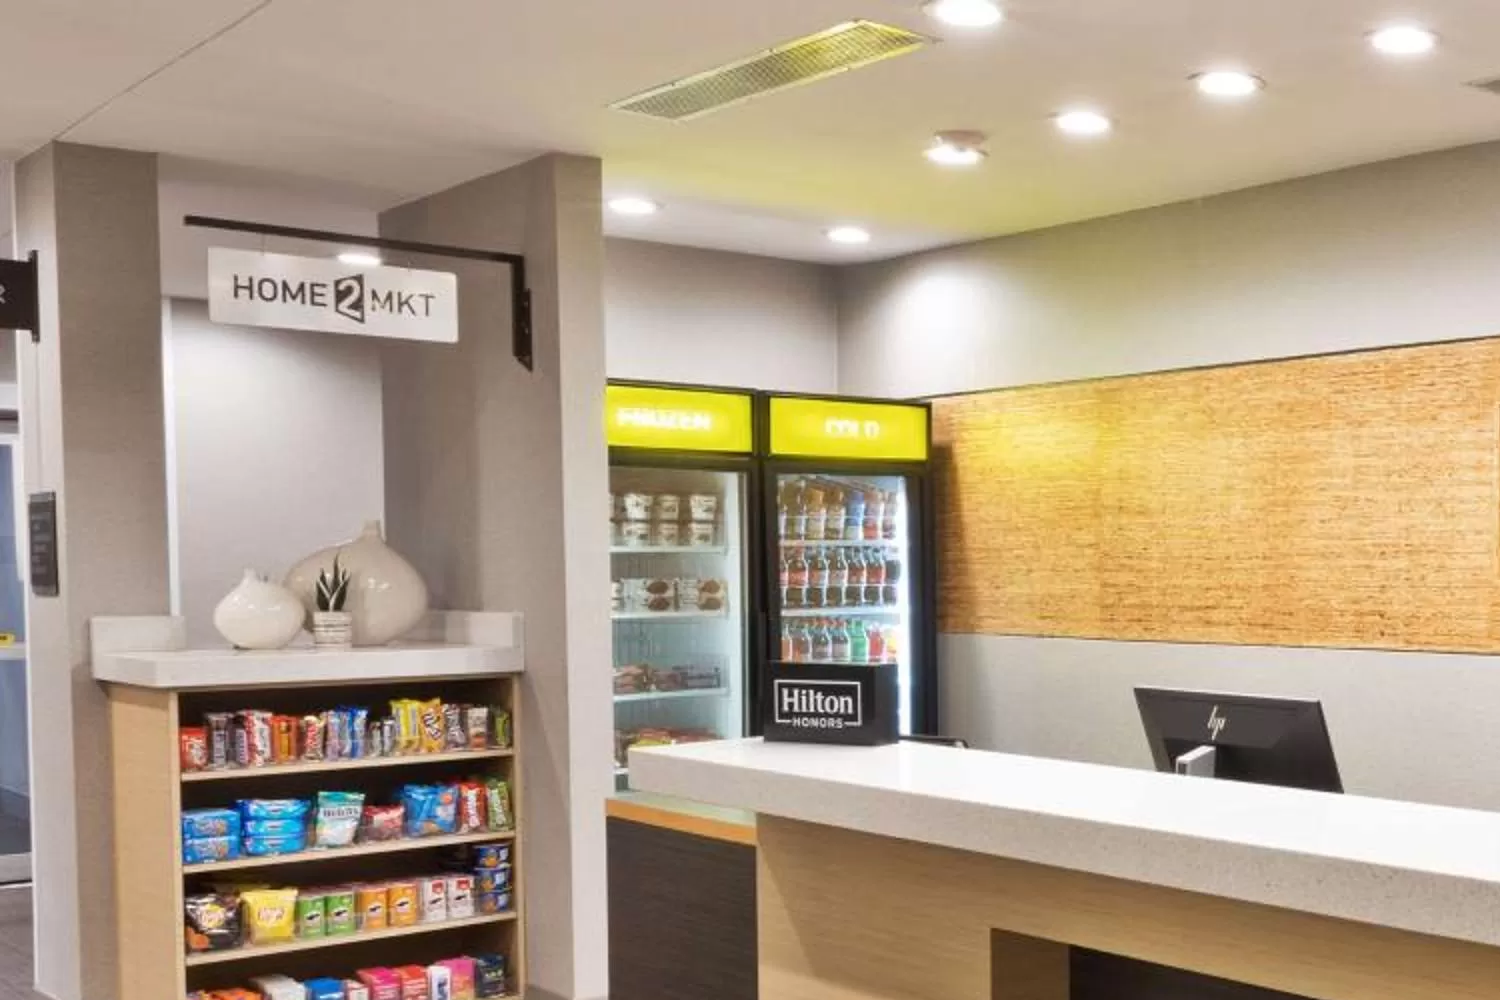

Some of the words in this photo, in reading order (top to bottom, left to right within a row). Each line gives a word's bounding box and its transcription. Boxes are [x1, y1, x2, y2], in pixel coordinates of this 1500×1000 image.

[233, 273, 328, 308] HOME
[337, 278, 362, 318] 2
[371, 288, 436, 318] MKT
[782, 687, 854, 715] Hilton
[791, 716, 844, 729] HONORS
[1207, 704, 1227, 741] hp
